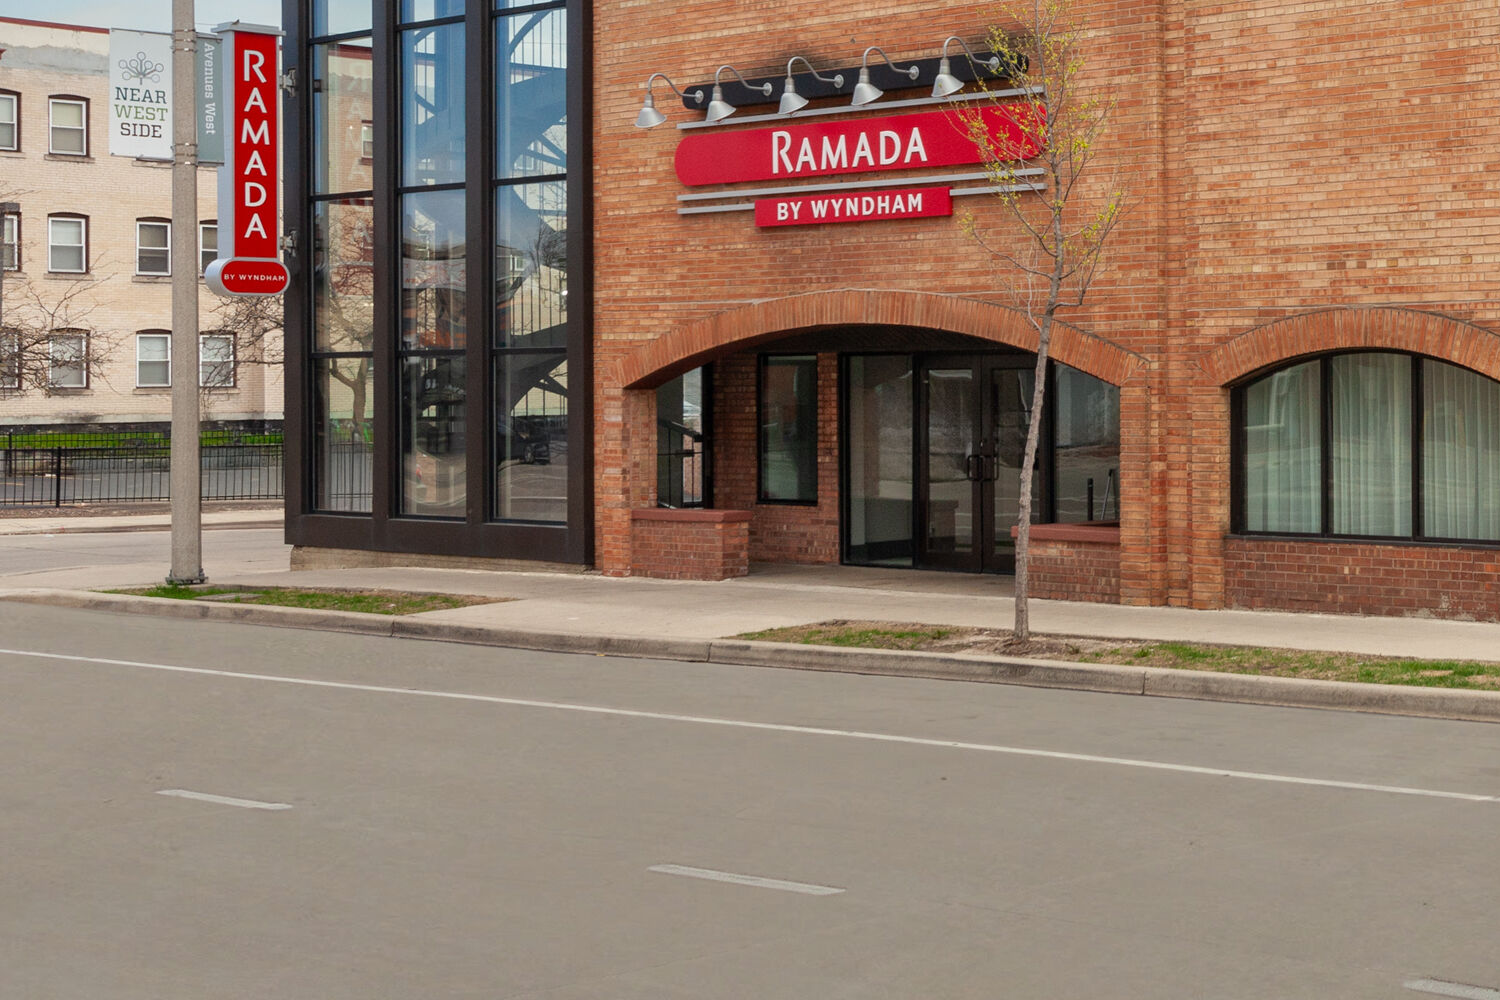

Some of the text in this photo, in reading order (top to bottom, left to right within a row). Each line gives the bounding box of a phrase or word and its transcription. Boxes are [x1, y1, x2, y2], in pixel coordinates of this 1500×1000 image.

[115, 87, 167, 104] NEAR
[204, 42, 217, 135] Avenues West
[114, 104, 168, 121] WEST
[120, 122, 162, 138] SIDE
[242, 49, 270, 239] RAMADA
[772, 127, 928, 174] RAMADA
[777, 193, 922, 221] BY WYNDHAM
